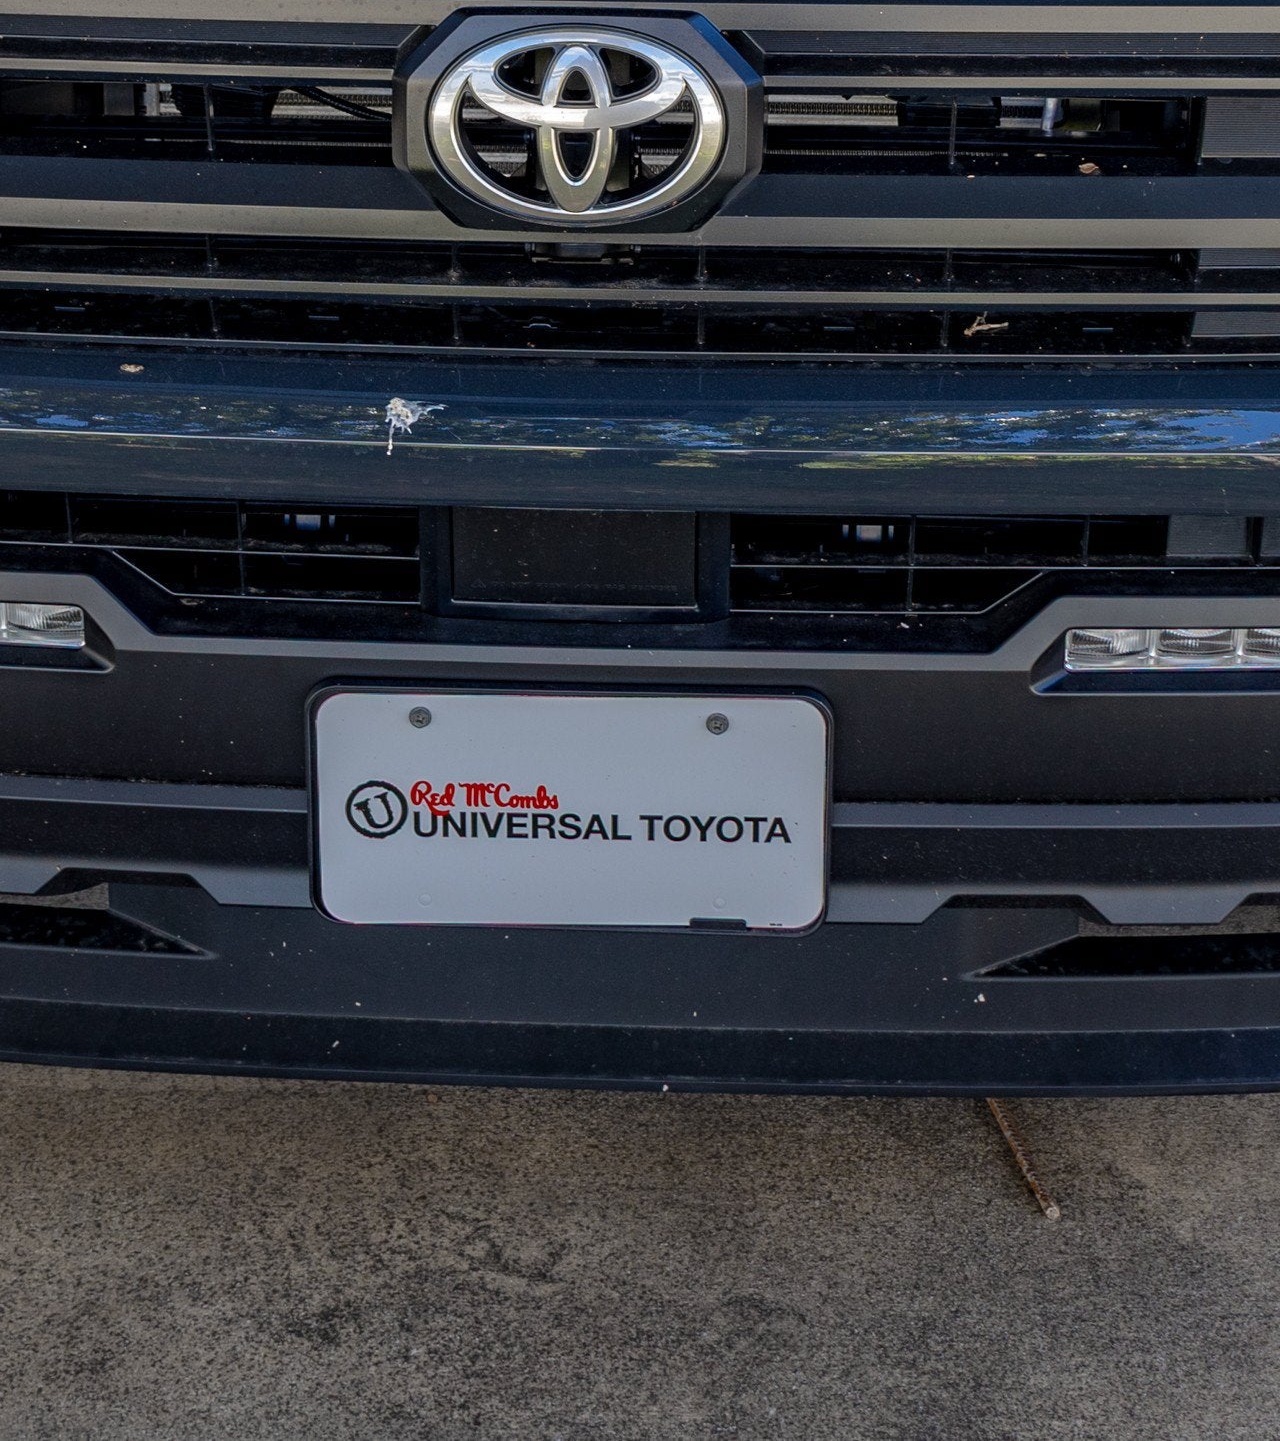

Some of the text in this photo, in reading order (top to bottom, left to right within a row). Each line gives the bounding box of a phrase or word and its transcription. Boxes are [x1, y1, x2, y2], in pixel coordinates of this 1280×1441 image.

[410, 780, 559, 816] Red McCombs
[413, 811, 792, 844] UNIVERSAL TOYOTA
